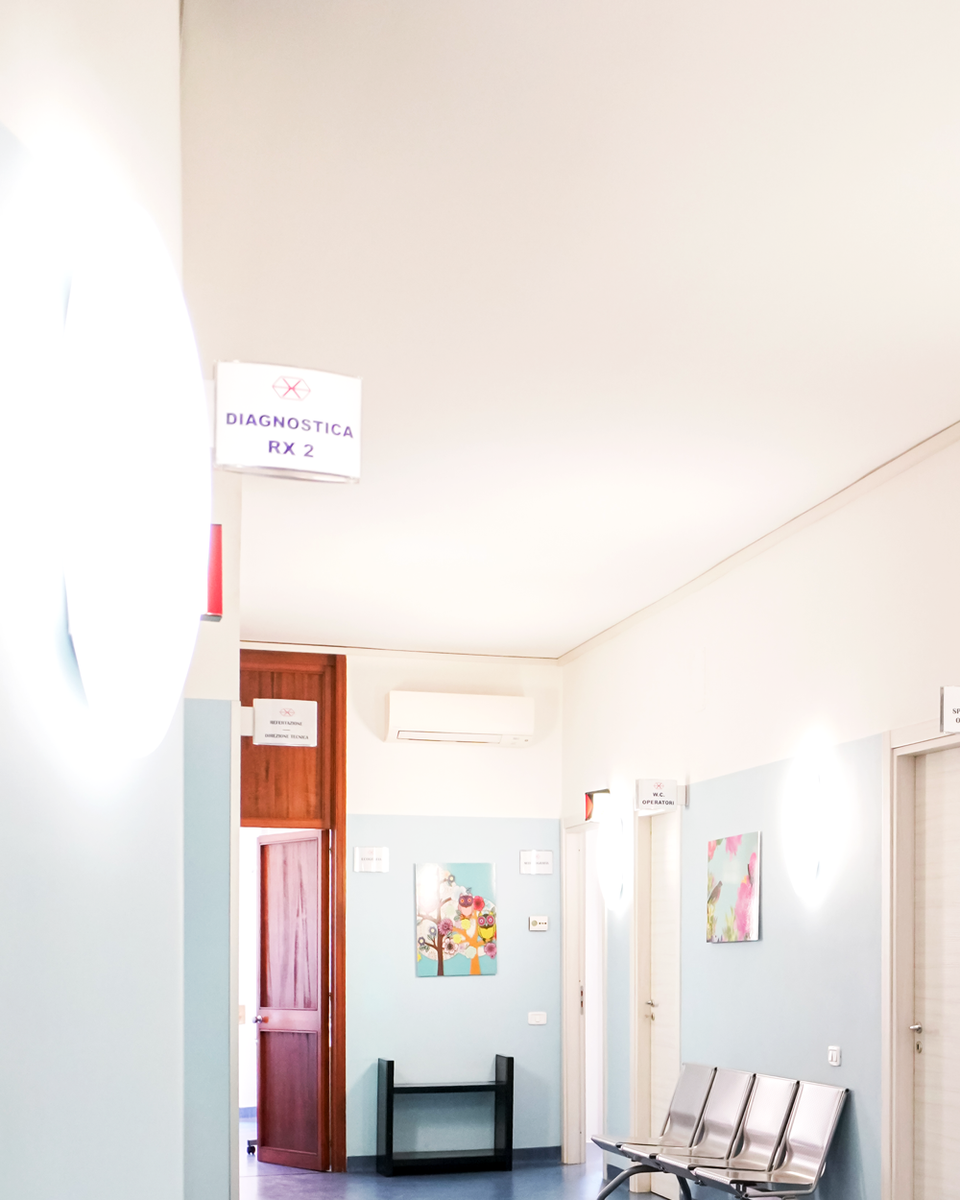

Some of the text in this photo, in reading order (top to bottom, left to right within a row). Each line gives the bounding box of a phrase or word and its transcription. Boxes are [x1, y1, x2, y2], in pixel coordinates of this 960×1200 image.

[226, 412, 354, 439] DIAGNOSTICA
[268, 440, 315, 458] RX 2
